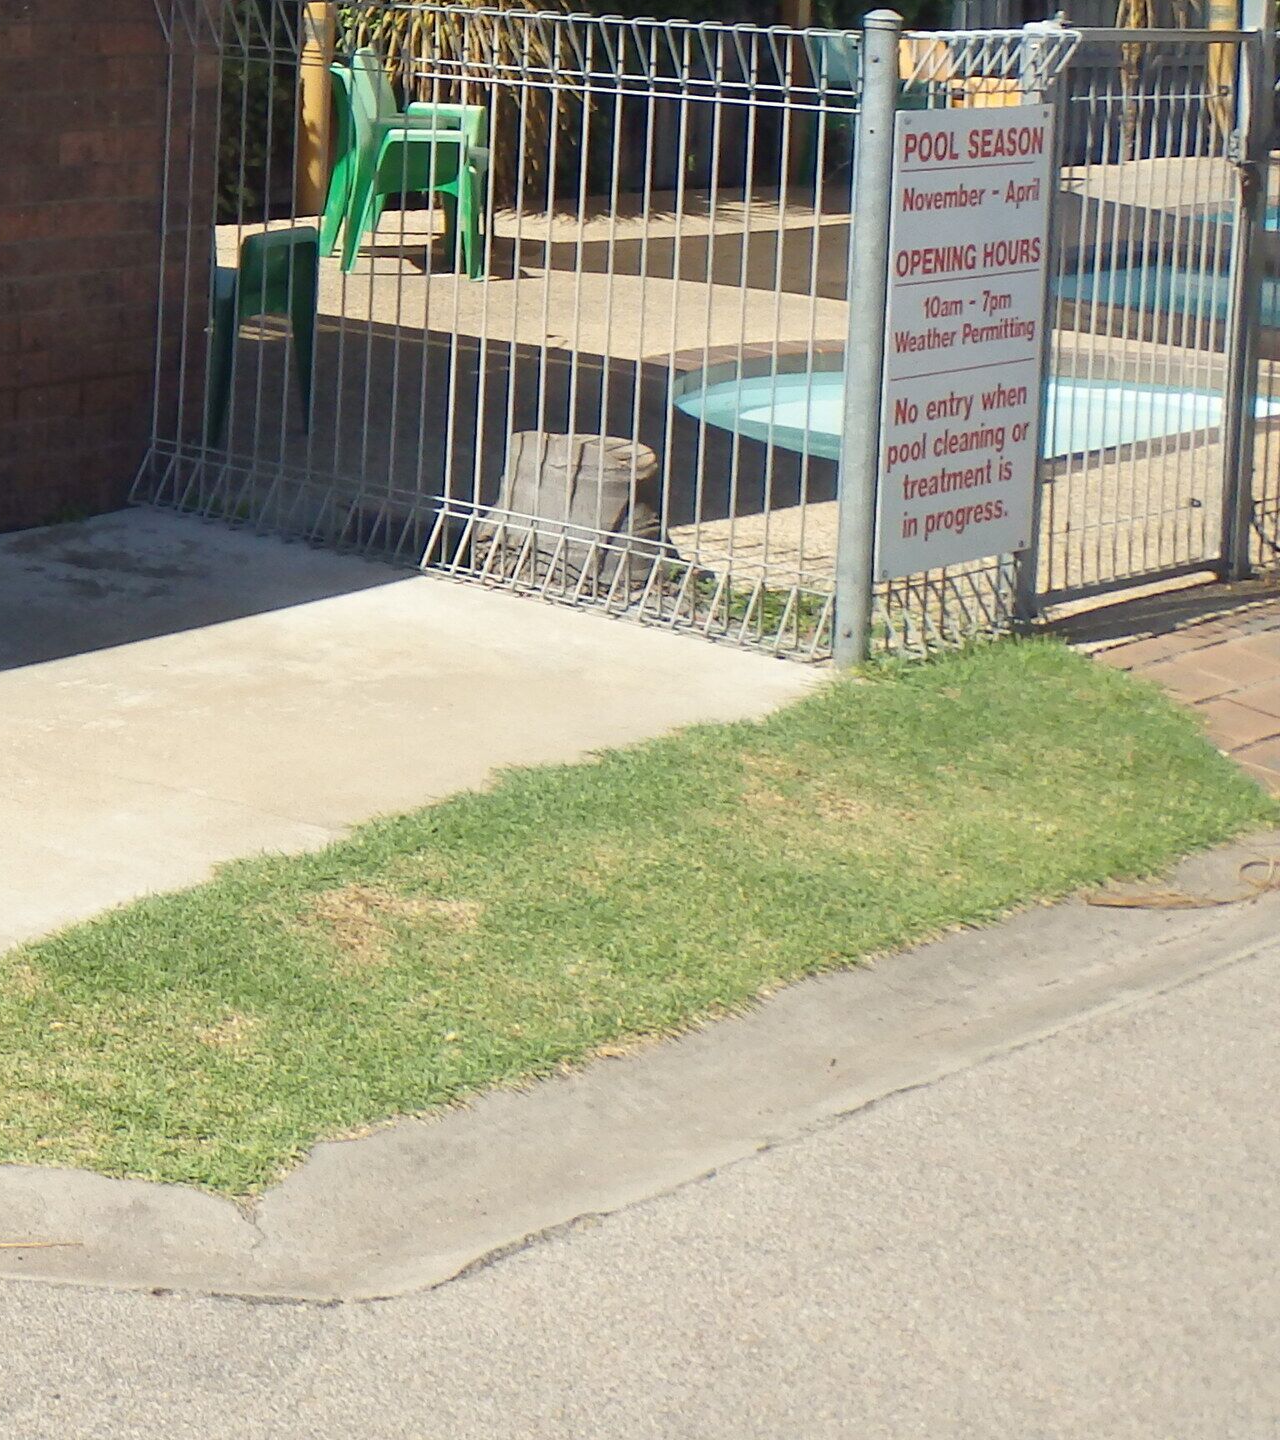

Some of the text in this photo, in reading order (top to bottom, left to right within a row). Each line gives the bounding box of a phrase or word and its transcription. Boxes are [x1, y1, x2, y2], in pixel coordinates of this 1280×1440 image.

[904, 126, 1044, 163] POOL SEASON
[902, 184, 986, 212] November
[1005, 177, 1040, 209] April
[896, 237, 1041, 277] OPENING HOURS
[923, 295, 963, 319] 10am
[982, 290, 1012, 316] 7pm
[895, 317, 1036, 354] Weather Permitting
[894, 383, 1027, 426] No entry when
[887, 422, 1029, 473] pool cleaning or
[903, 456, 1013, 501] treatment is
[902, 498, 1008, 542] in progress.
